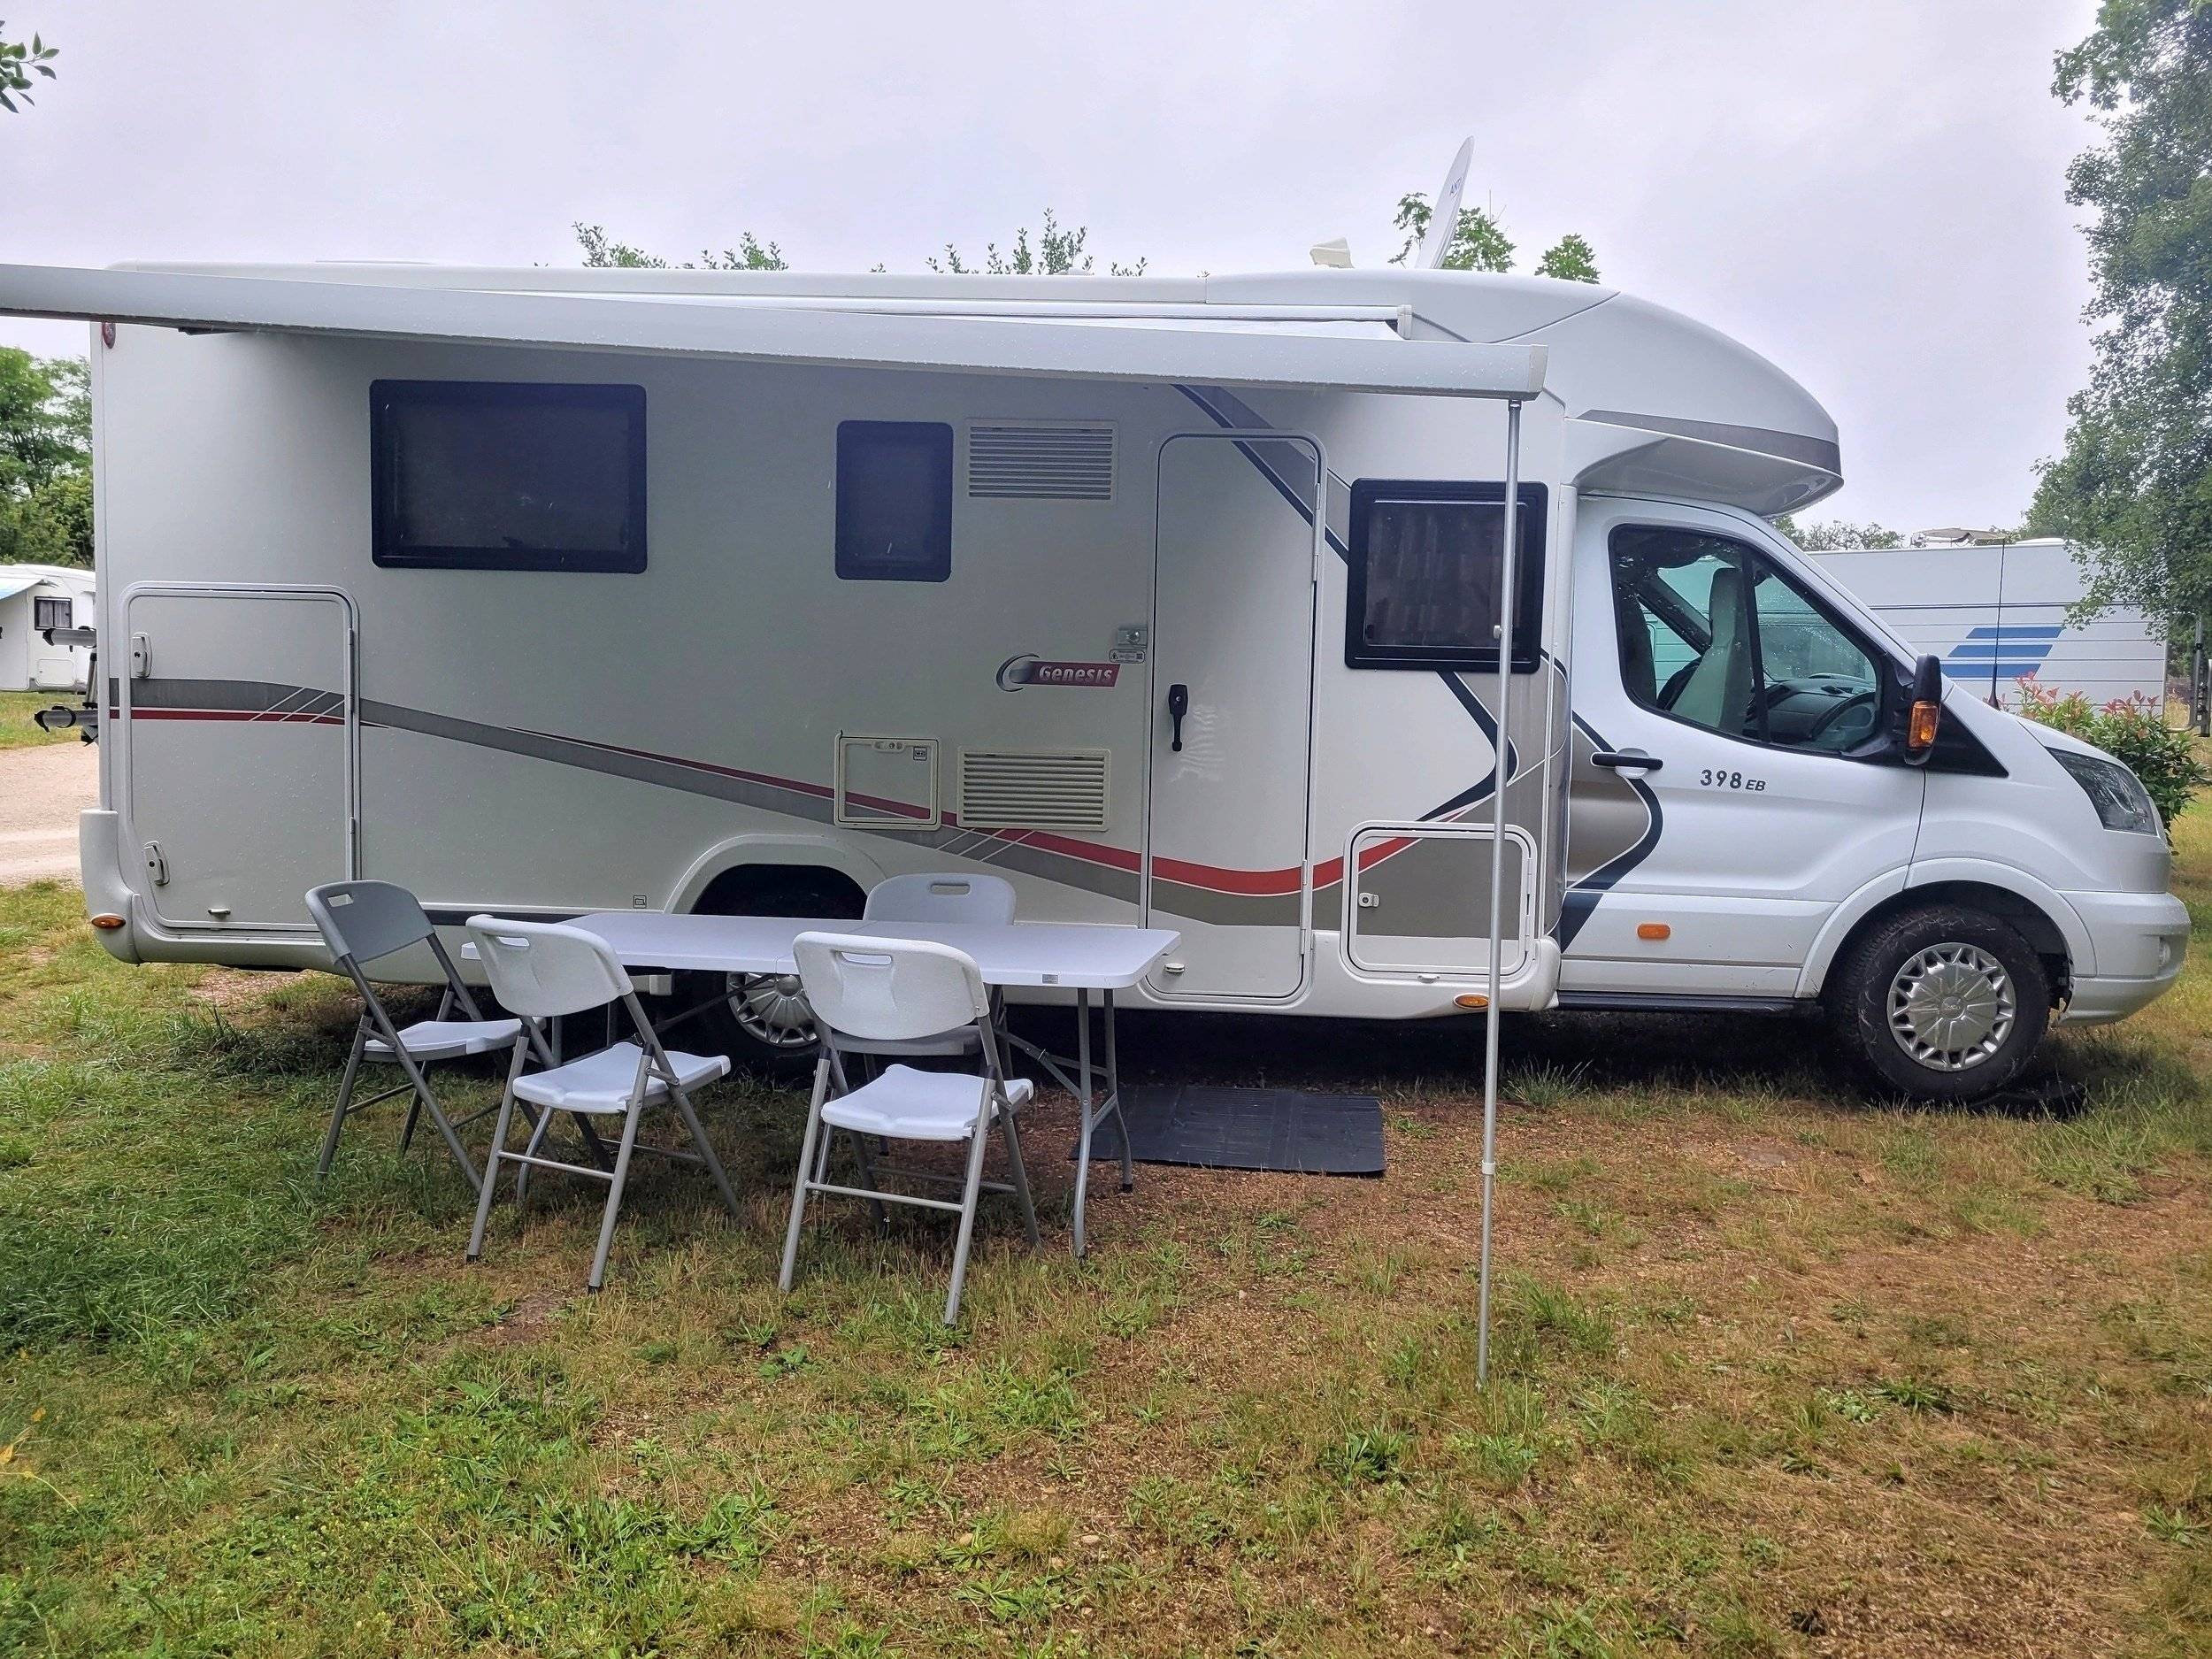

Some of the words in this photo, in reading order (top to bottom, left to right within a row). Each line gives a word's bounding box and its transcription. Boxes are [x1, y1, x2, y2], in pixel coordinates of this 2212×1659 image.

[1039, 664, 1113, 683] Genesis
[1700, 769, 1742, 789] 398
[1745, 780, 1766, 791] EB
